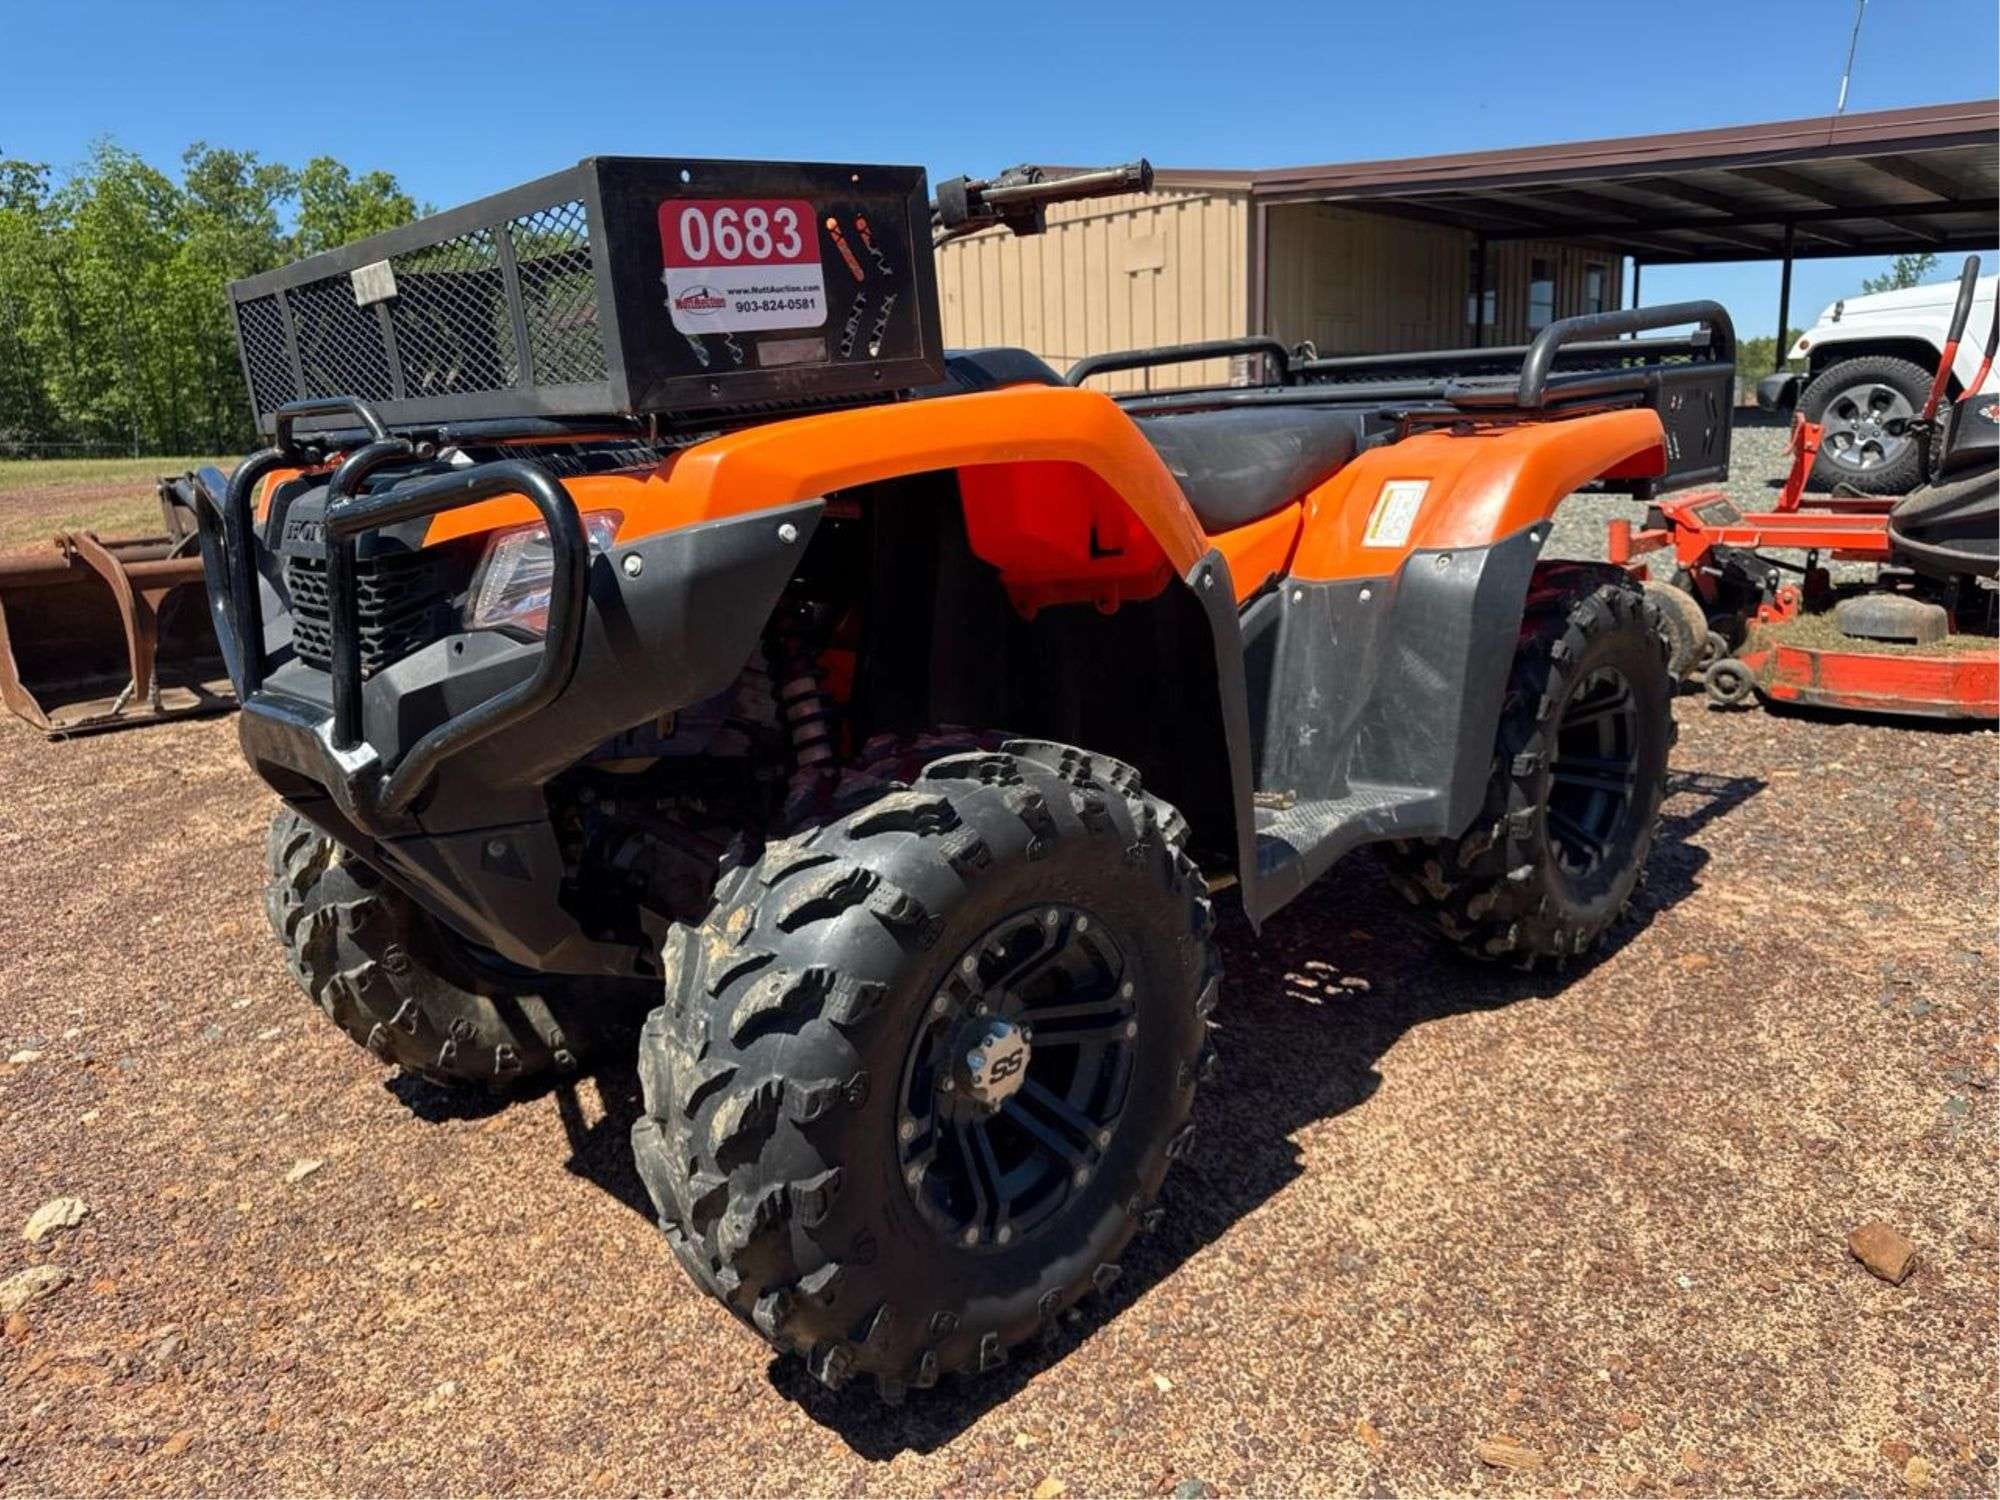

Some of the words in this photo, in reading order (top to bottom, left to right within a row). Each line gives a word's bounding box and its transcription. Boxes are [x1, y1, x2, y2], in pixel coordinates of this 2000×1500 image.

[680, 207, 802, 261] 0683
[727, 285, 820, 295] www.NuttAuction.com
[736, 299, 815, 313] 903-824-0581
[989, 1047, 1023, 1084] SS
